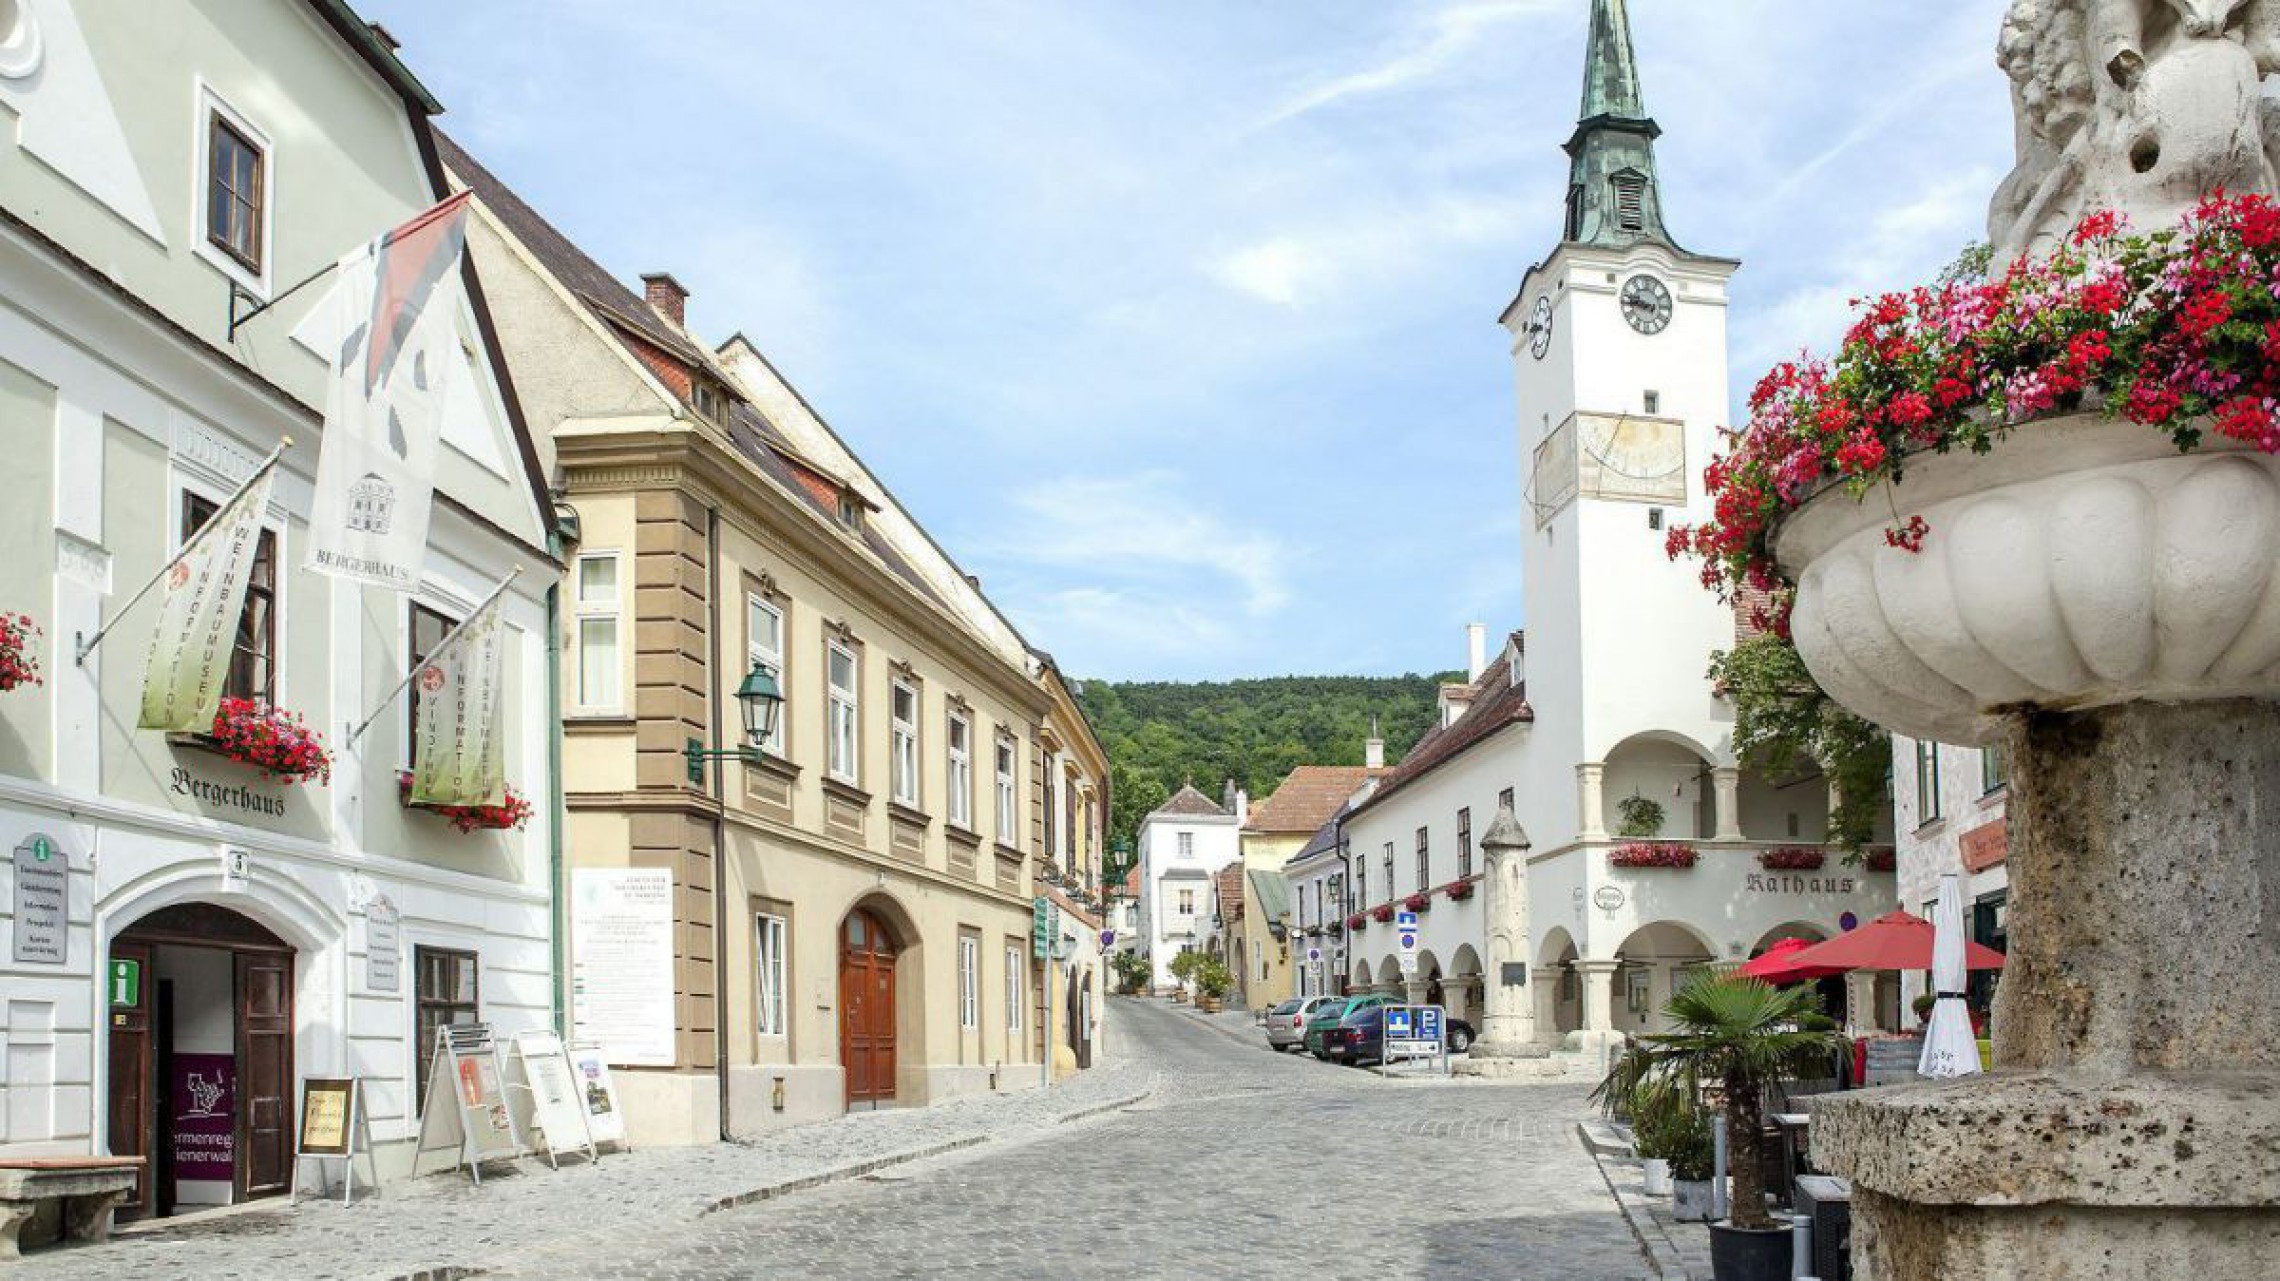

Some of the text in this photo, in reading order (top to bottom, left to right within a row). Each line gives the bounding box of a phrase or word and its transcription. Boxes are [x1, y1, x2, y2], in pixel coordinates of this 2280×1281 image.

[454, 660, 466, 801] INFORMATION
[170, 767, 286, 818] Bergerhaus
[1747, 873, 1855, 896] Rathaus
[1422, 1010, 1435, 1029] P
